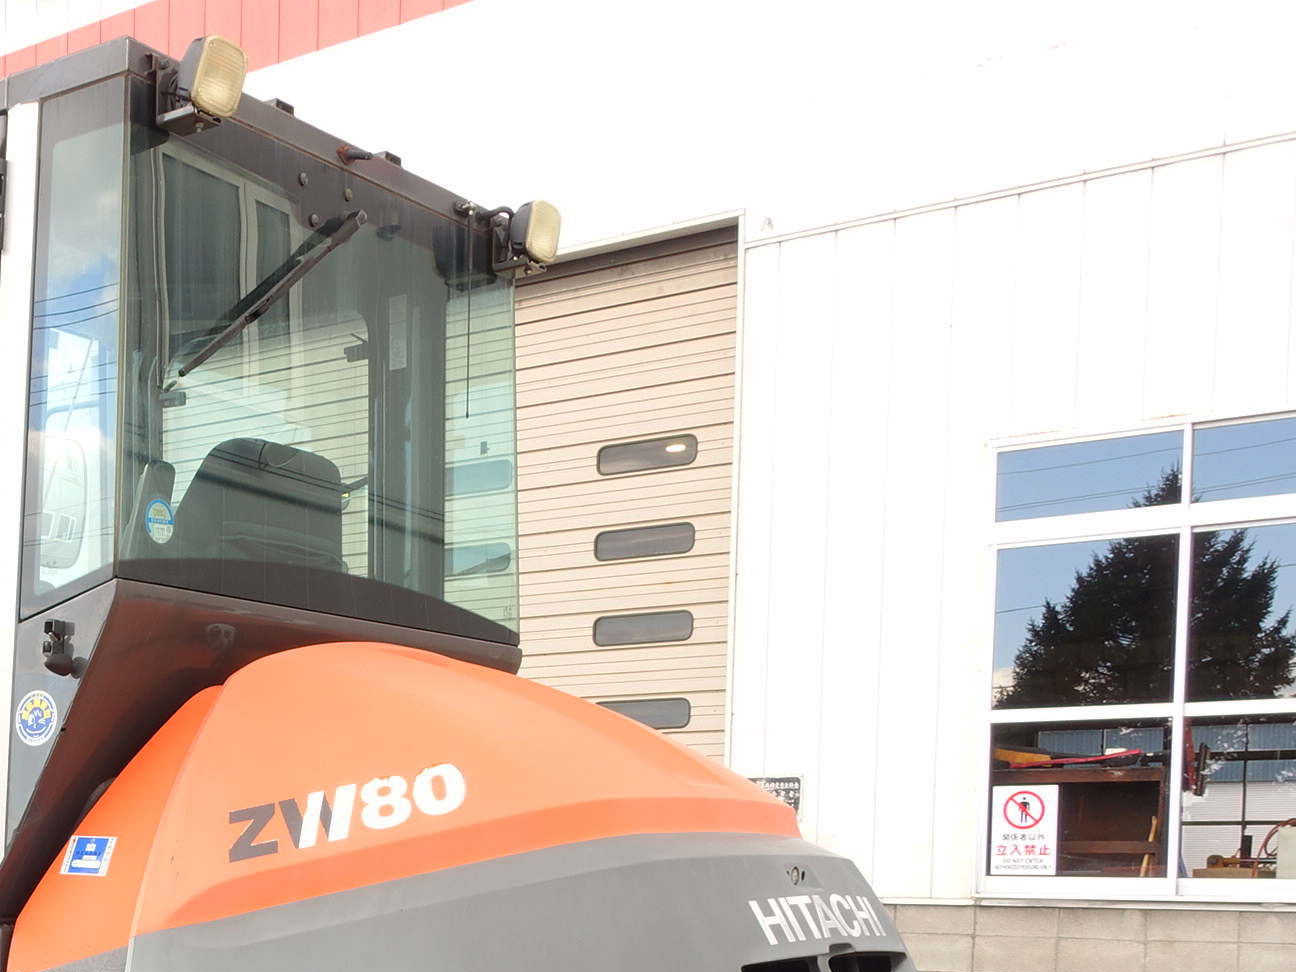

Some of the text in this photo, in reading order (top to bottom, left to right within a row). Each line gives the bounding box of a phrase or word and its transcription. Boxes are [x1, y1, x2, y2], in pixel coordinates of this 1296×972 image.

[229, 763, 466, 863] ZW80
[996, 844, 1051, 856] 立入禁止
[748, 893, 887, 946] HITACHI
